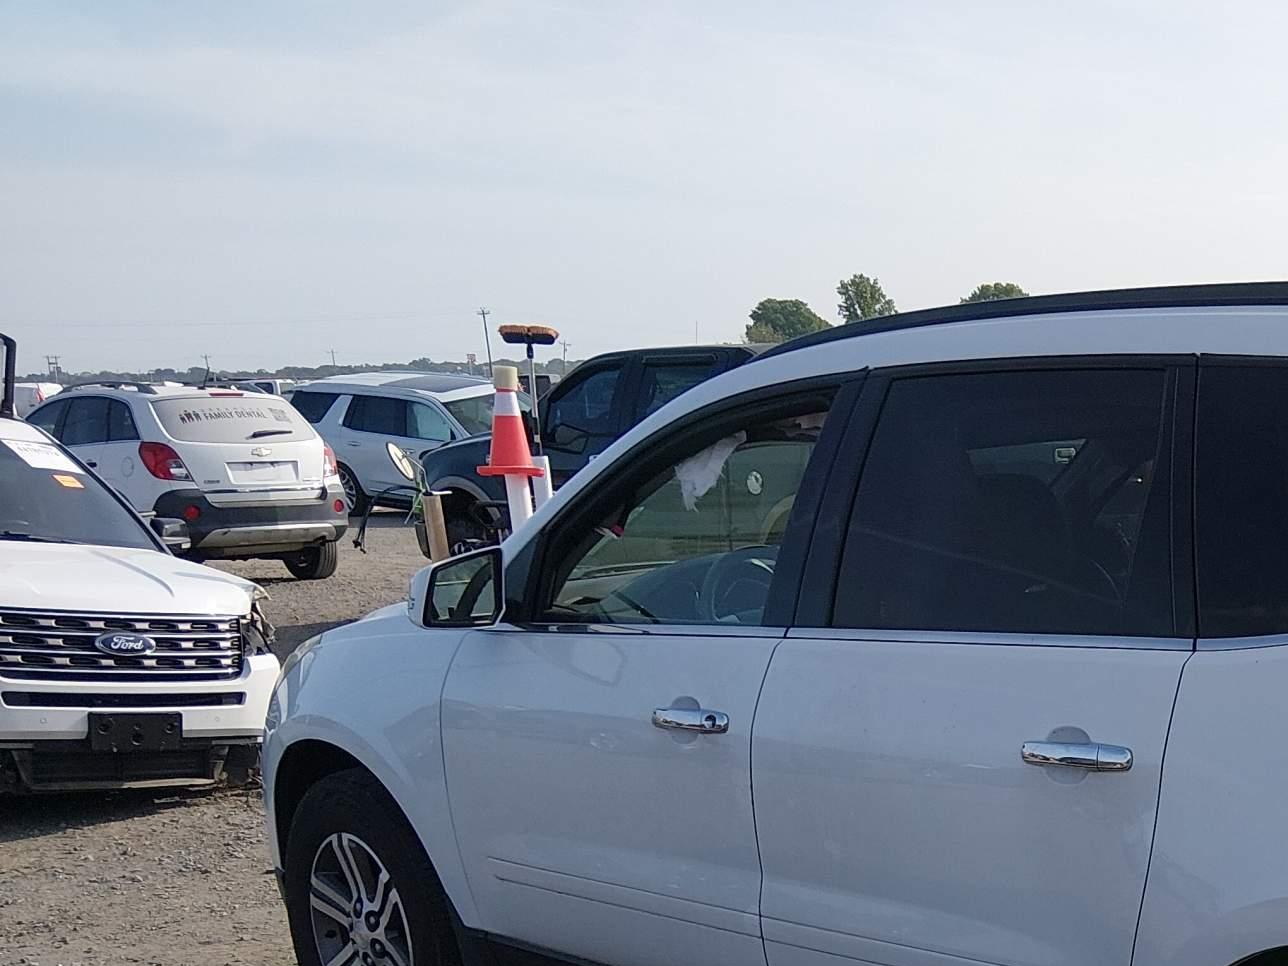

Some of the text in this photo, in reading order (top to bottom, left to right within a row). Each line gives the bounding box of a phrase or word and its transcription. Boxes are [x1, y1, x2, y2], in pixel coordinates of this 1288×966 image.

[203, 410, 267, 420] FAMILY DENTAL
[111, 636, 144, 650] Ford
